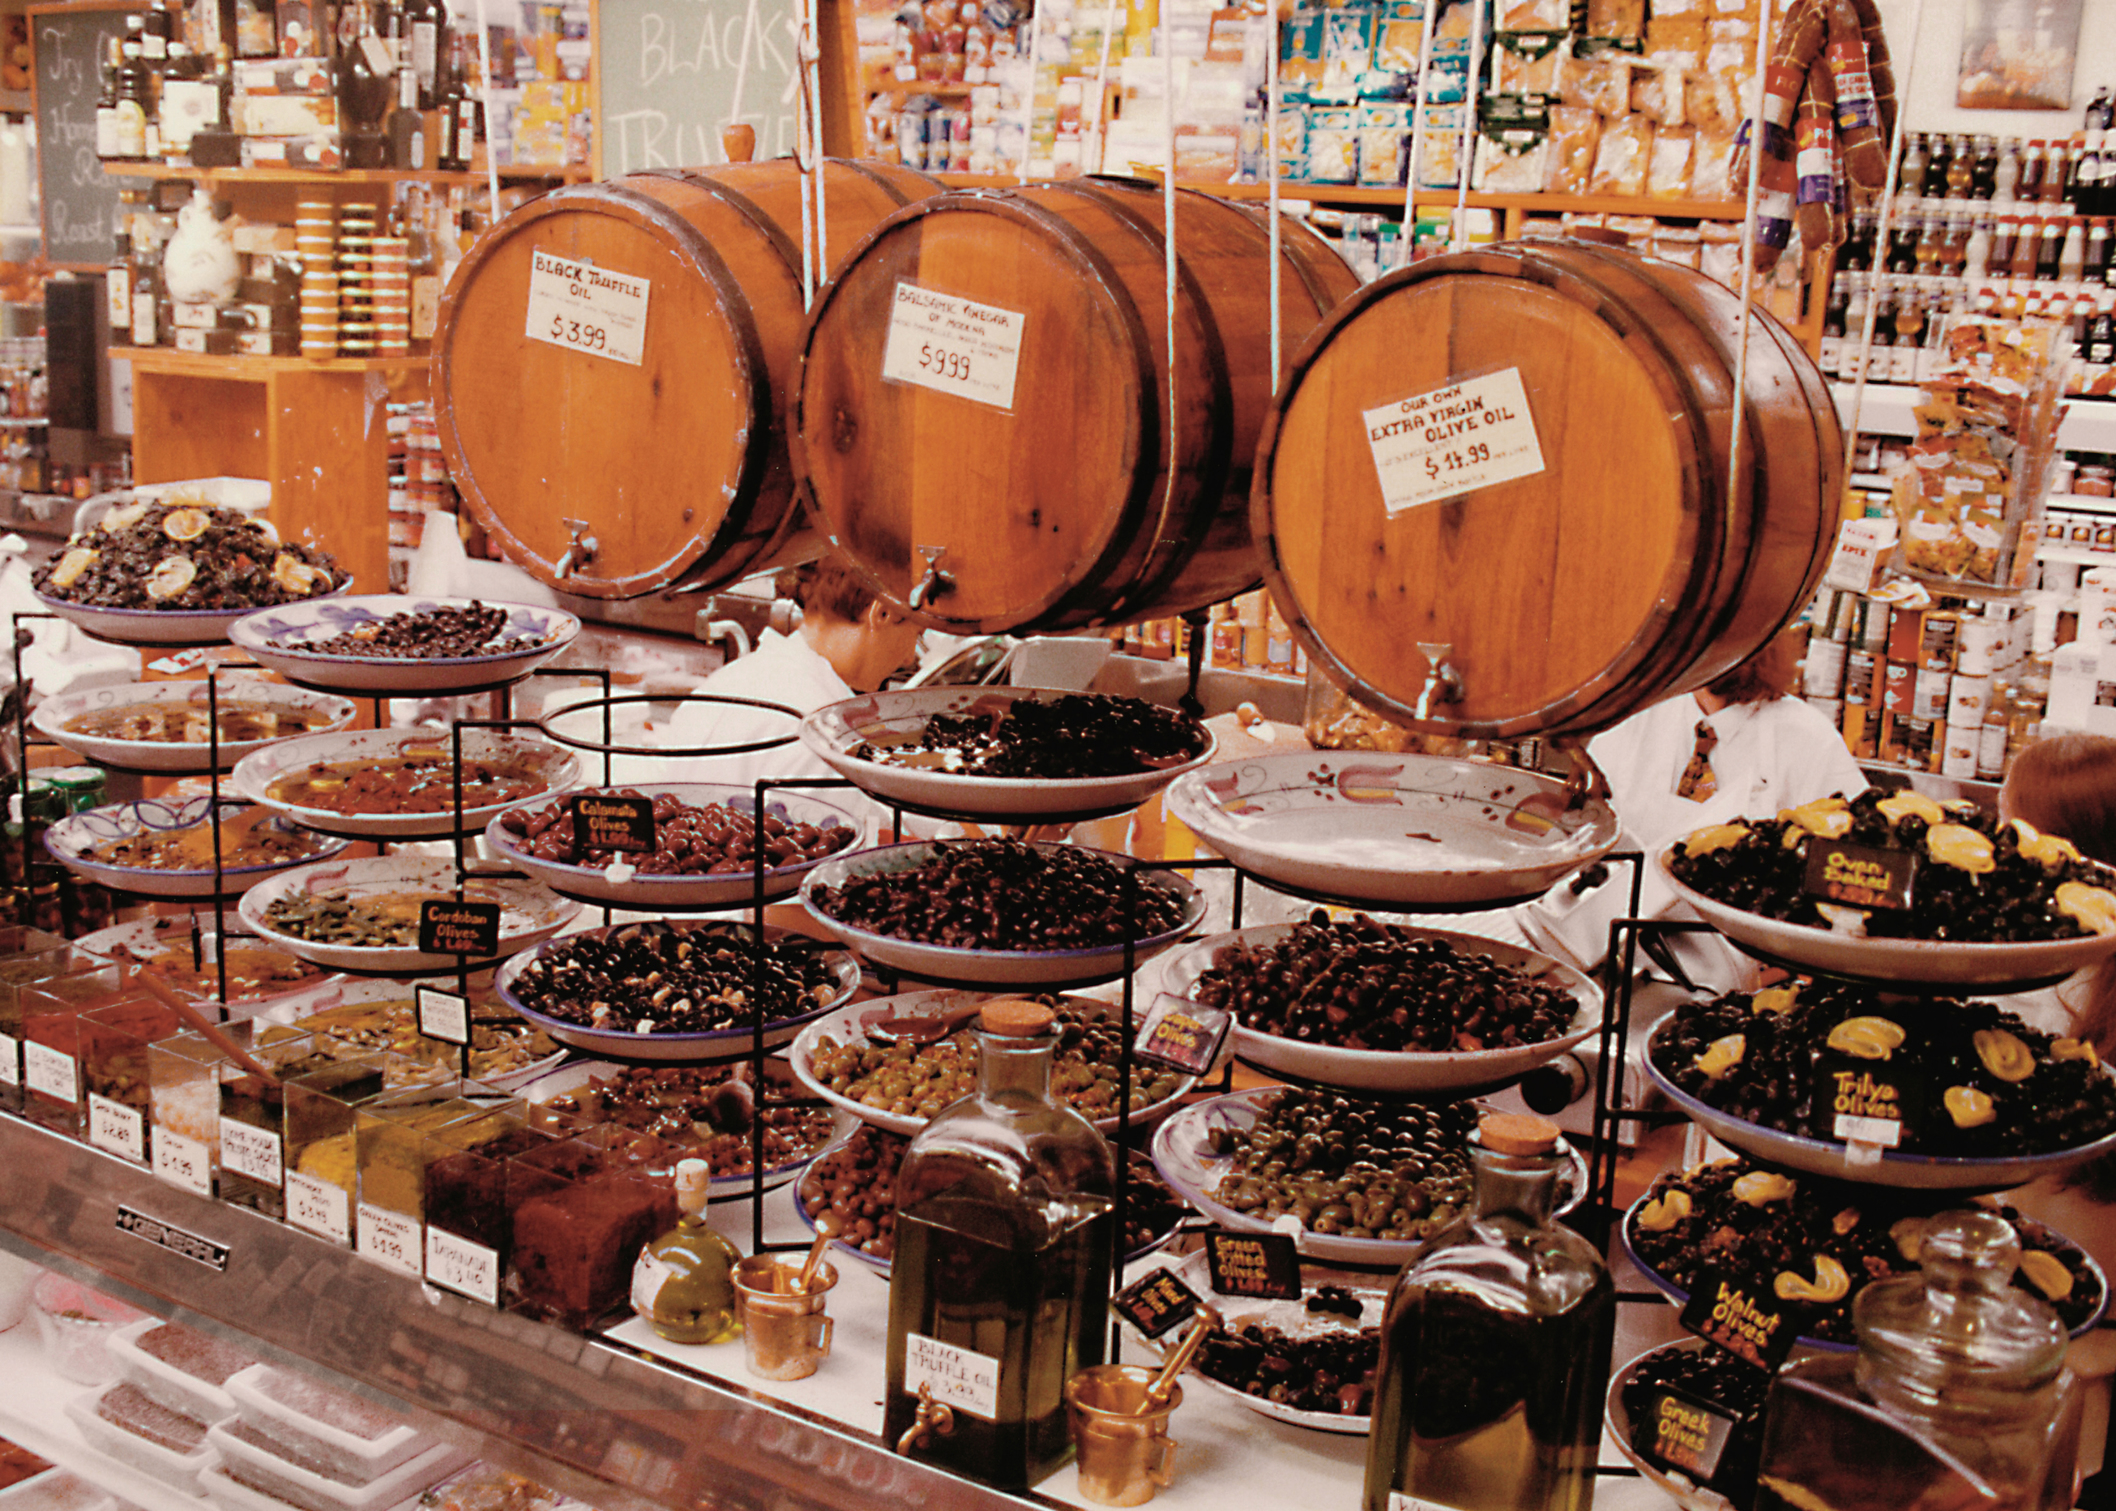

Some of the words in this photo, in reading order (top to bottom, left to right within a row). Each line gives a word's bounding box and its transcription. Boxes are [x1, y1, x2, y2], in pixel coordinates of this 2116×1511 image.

[641, 10, 790, 88] BLACK
[536, 256, 582, 282] BLACK
[588, 270, 641, 298] TRUFFLE
[570, 283, 591, 300] OIL
[963, 304, 1009, 327] VINEGAR
[1401, 397, 1428, 413] OUR
[1433, 385, 1462, 404] OWN
[1371, 415, 1425, 442] EXTRA
[1430, 396, 1484, 423] VIRGIN
[1425, 417, 1478, 443] OLIVE
[1483, 406, 1515, 425] OIL
[589, 816, 630, 832] Olives
[1827, 852, 1884, 875] Oven
[1824, 866, 1892, 891] Baked
[427, 905, 488, 925] Cordoban
[436, 923, 480, 939] Olives
[1156, 1022, 1196, 1048] Olives
[1833, 1094, 1901, 1118] Olives
[1141, 1288, 1168, 1315] Olives
[1717, 1281, 1781, 1335] Walnut
[1712, 1303, 1768, 1348] Olives
[1661, 1396, 1710, 1434] Greek
[1659, 1418, 1705, 1451] Olives
